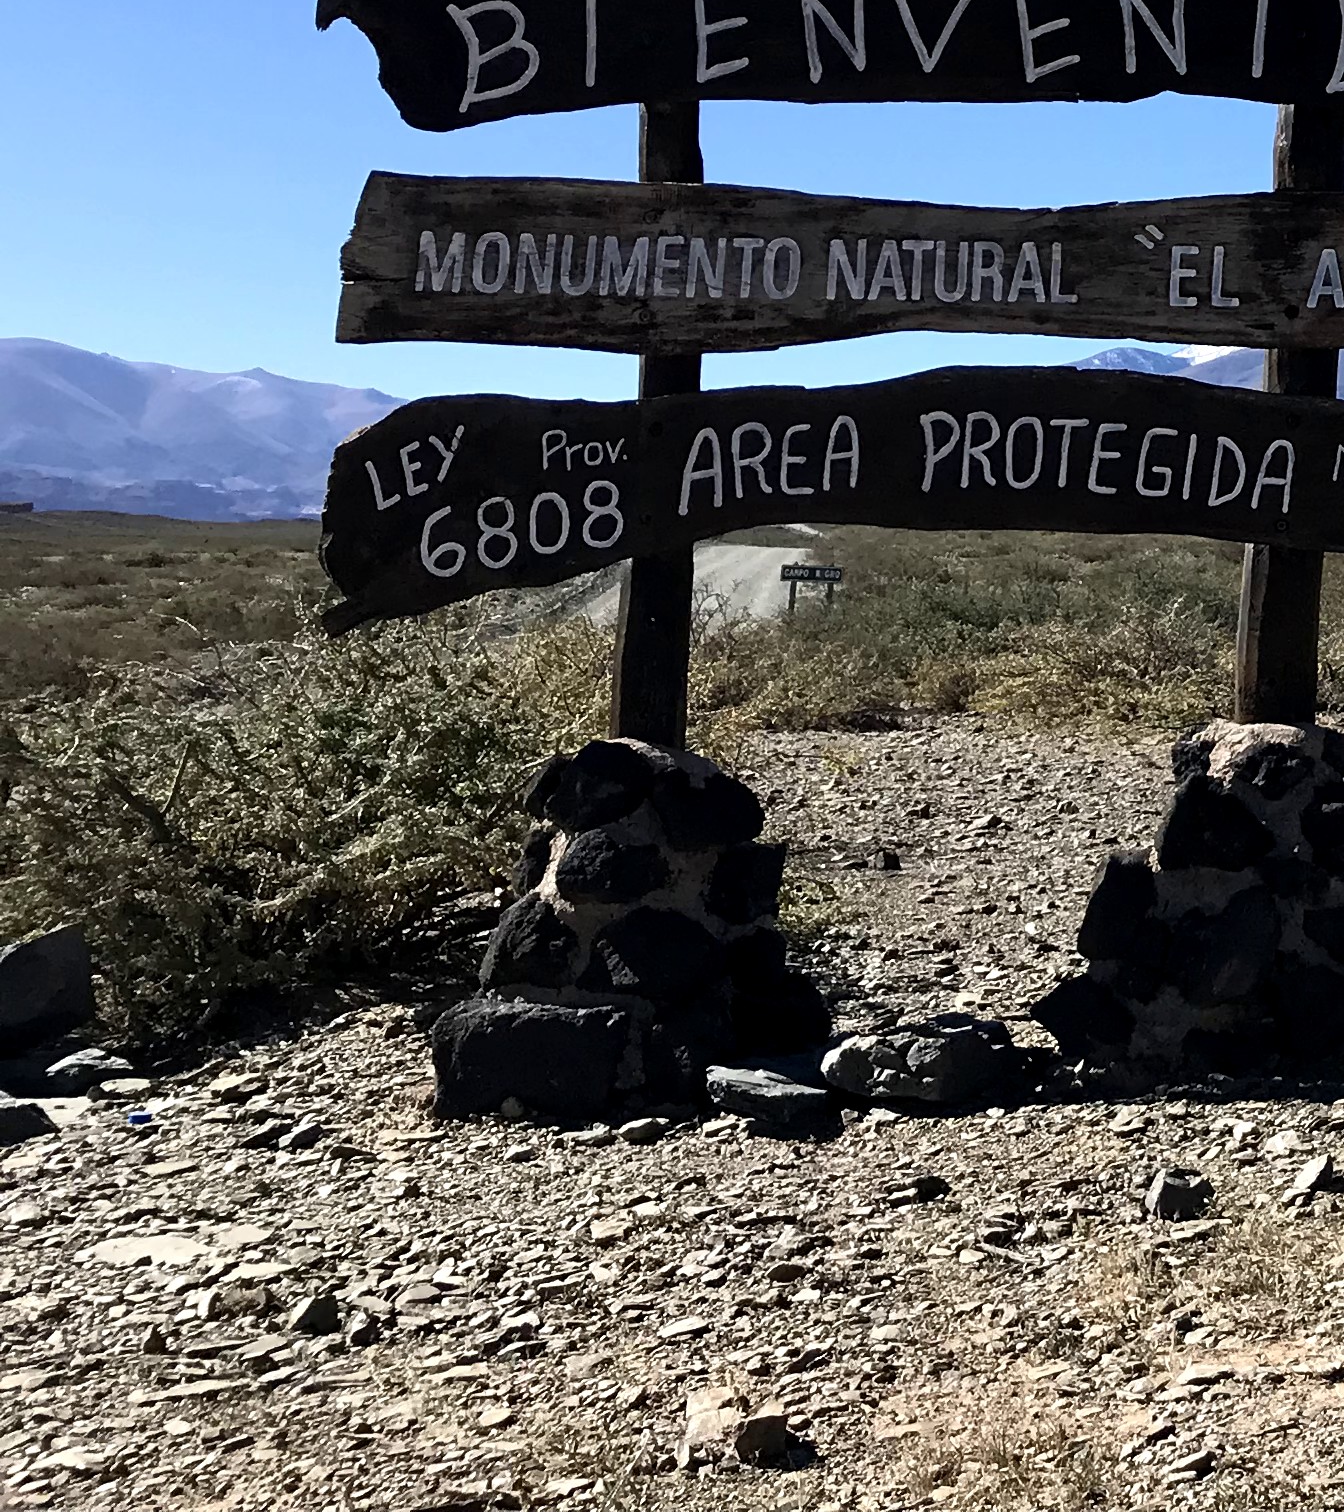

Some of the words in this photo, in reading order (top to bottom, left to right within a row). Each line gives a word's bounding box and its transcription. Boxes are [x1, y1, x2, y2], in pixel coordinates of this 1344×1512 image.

[414, 230, 801, 301] MONUMENTO
[825, 238, 1079, 304] NATURAL
[364, 425, 465, 511] LEY
[541, 429, 629, 472] Prov.
[679, 414, 861, 516] AREA
[919, 410, 1297, 514] PROTEGIDA
[419, 480, 625, 578] 6808
